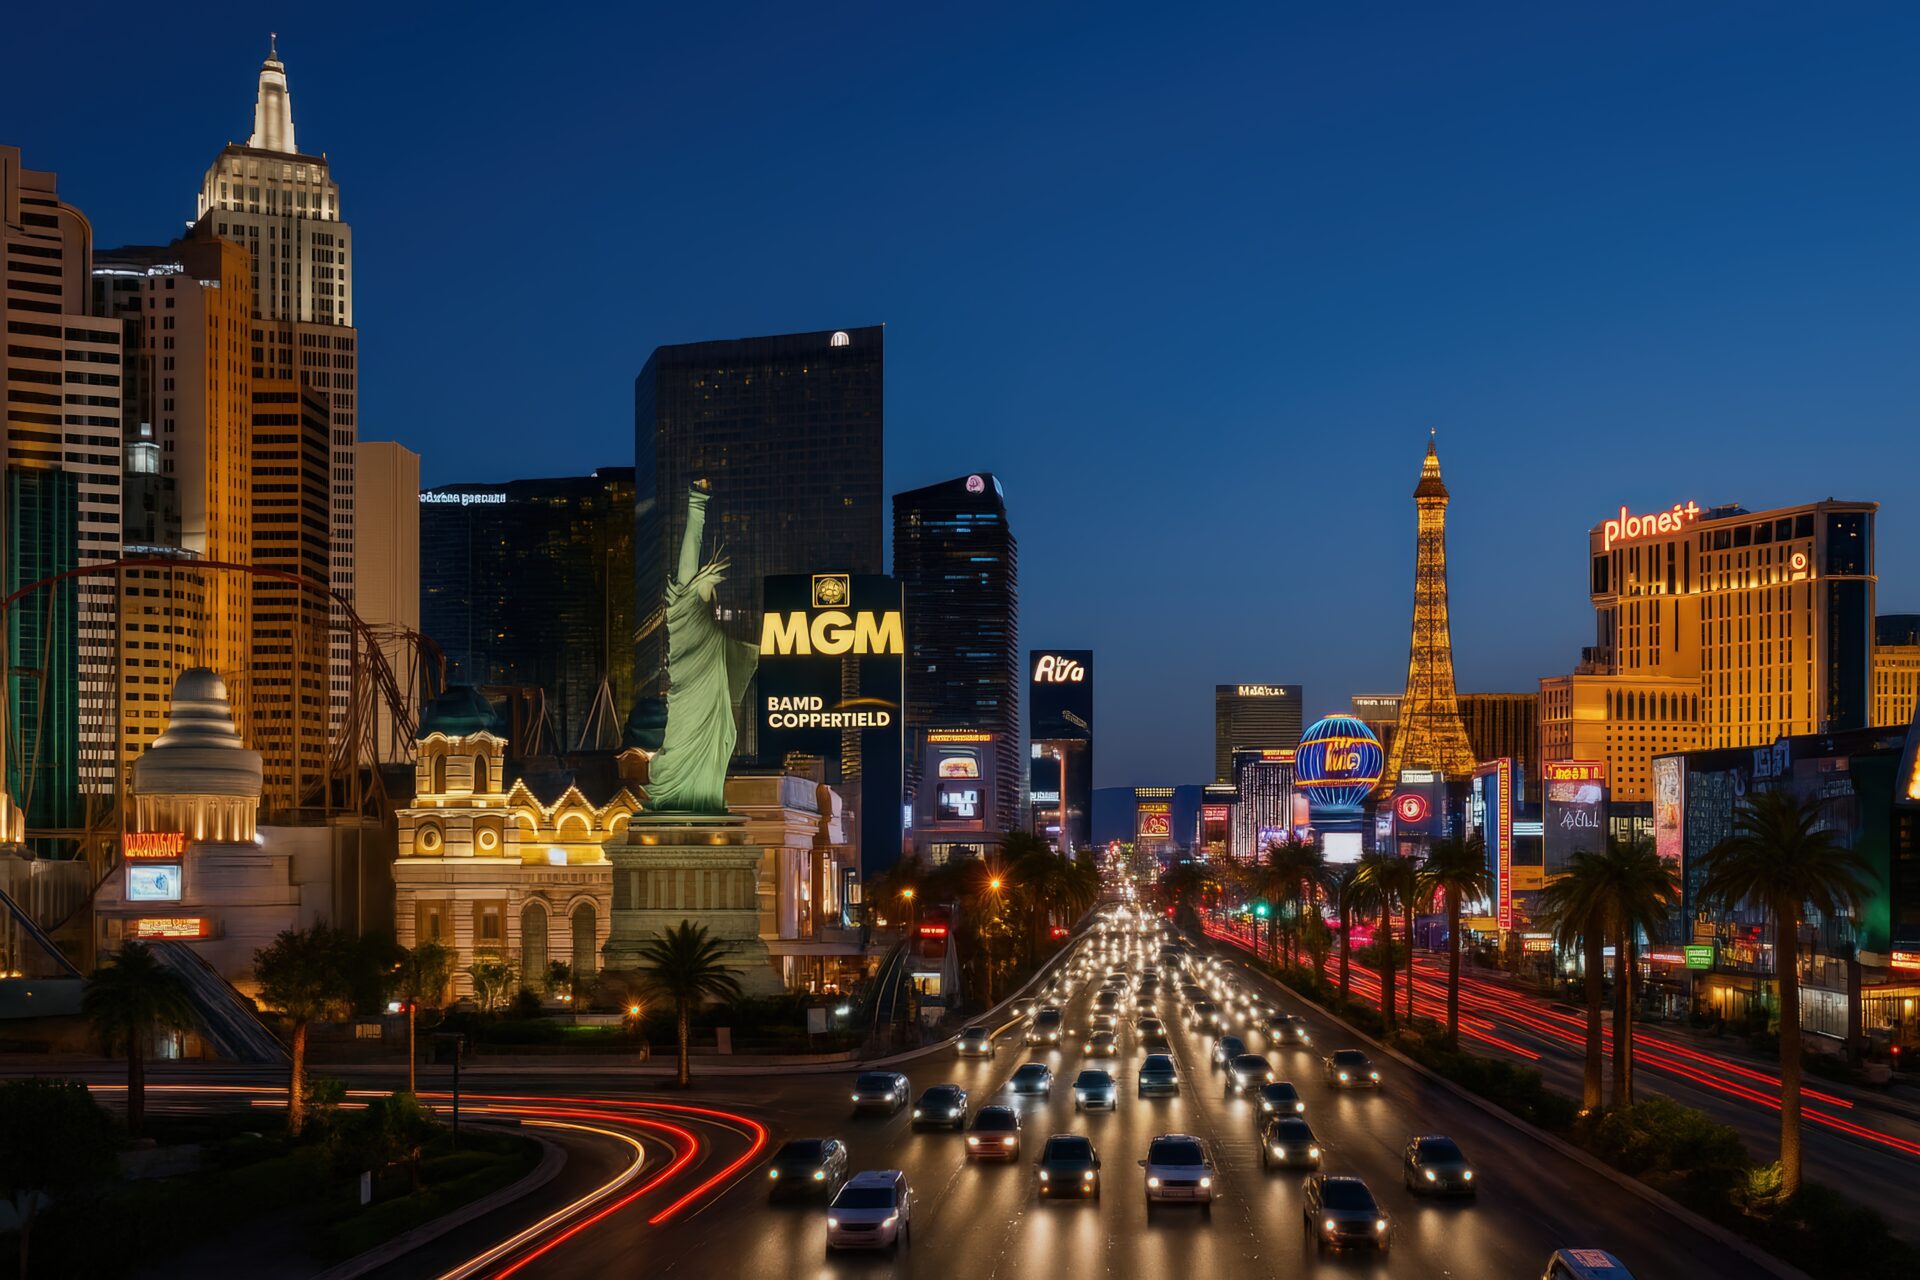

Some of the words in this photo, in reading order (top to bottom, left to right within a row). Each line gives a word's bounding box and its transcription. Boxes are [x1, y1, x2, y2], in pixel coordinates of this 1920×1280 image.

[760, 611, 904, 655] MGM
[767, 696, 823, 711] BAMD
[768, 711, 890, 728] COPPERTIELD
